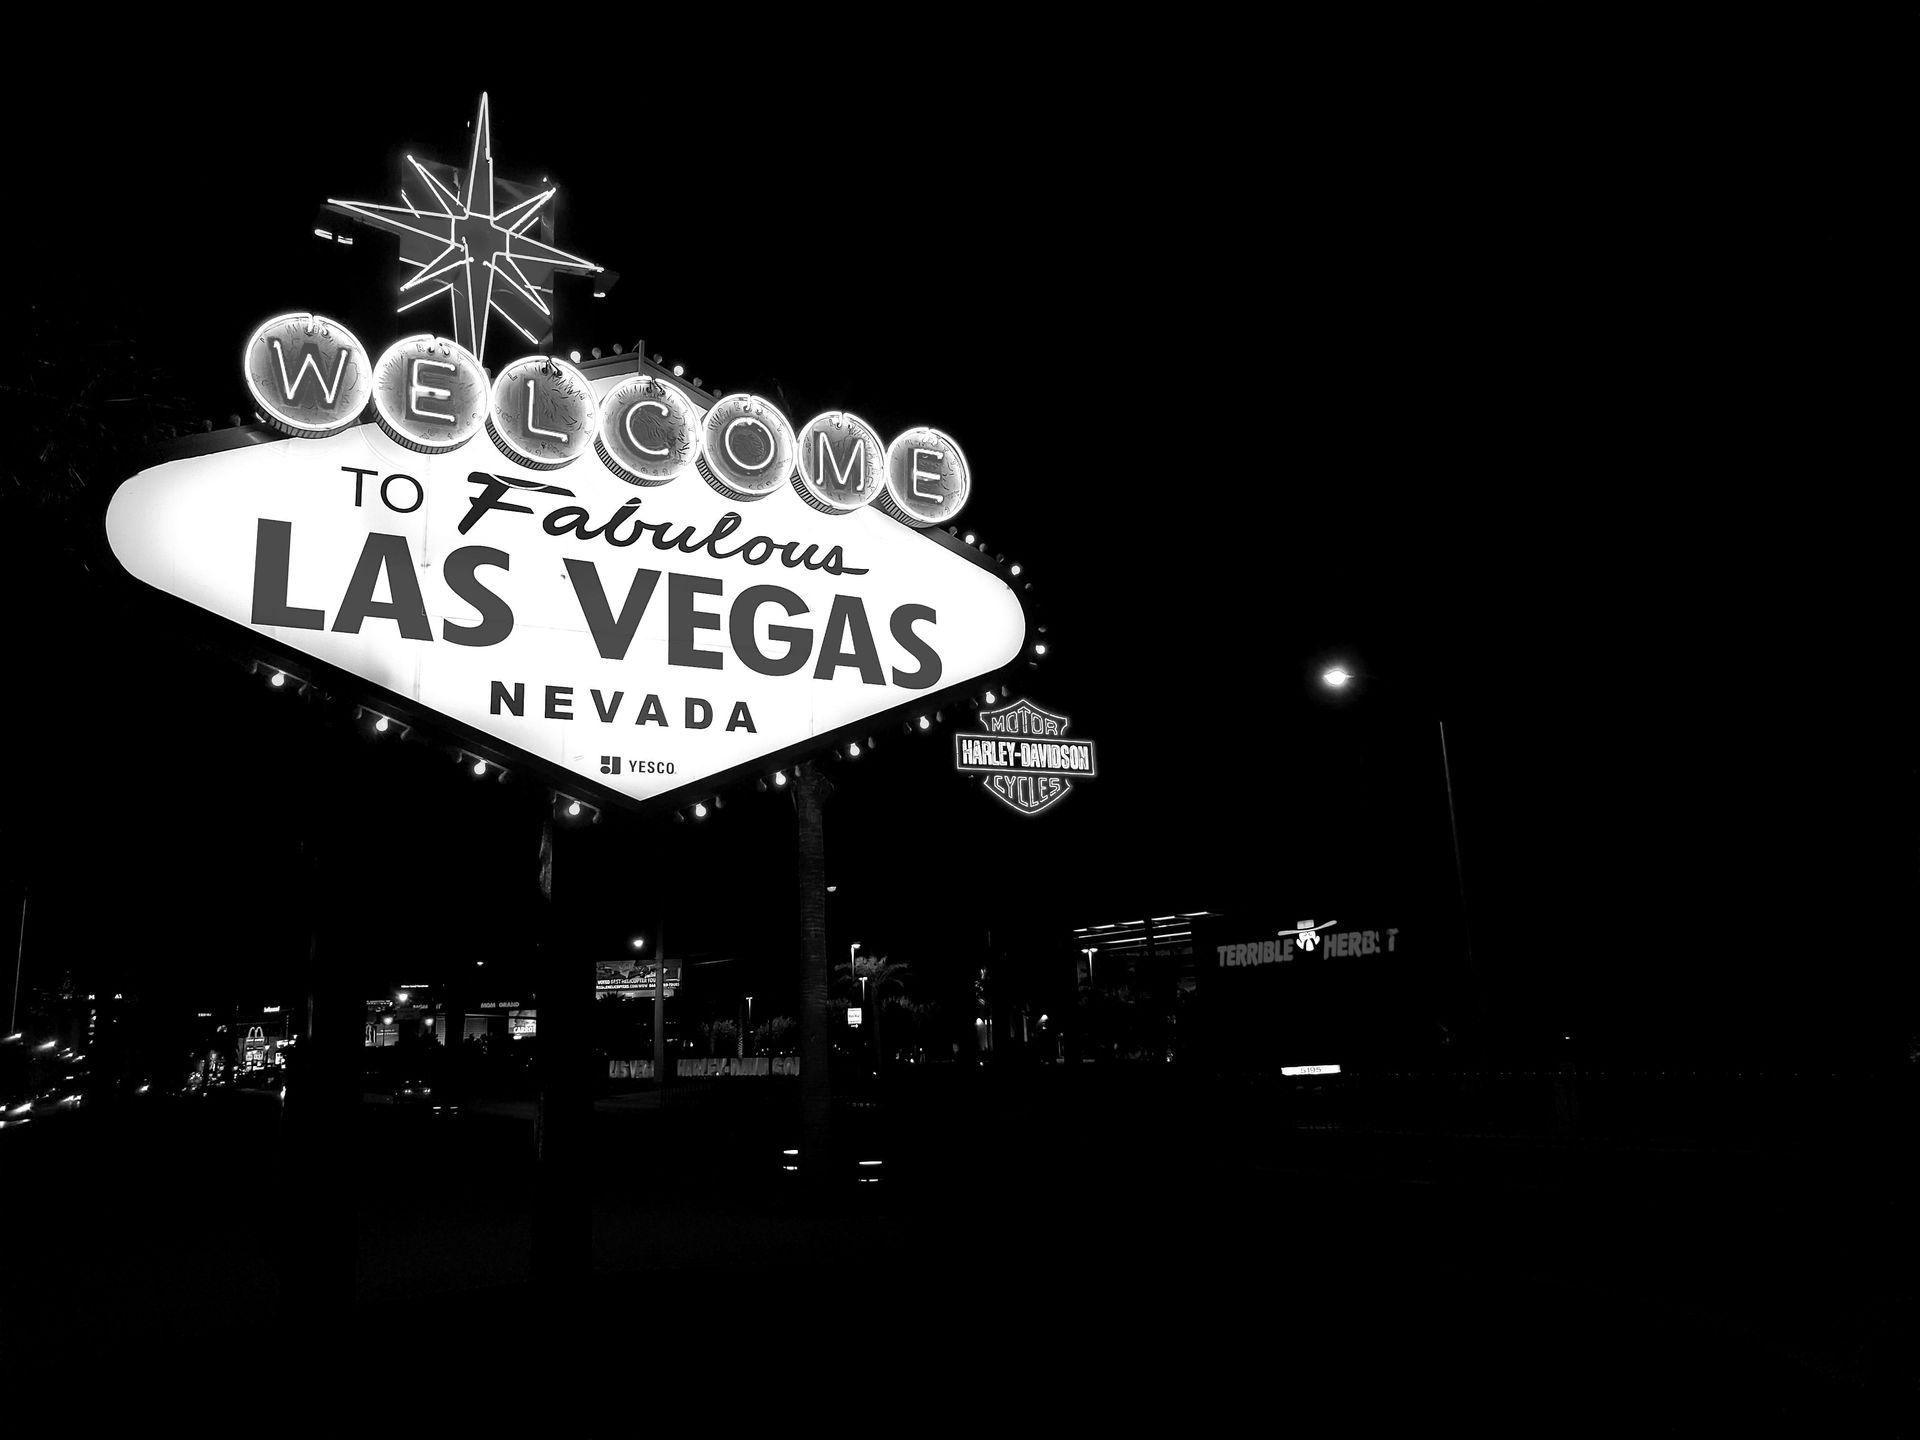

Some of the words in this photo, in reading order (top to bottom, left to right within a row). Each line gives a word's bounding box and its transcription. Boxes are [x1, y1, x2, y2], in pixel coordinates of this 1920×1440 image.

[262, 330, 948, 506] WELCOME
[341, 466, 424, 513] TO
[458, 471, 869, 575] Fabulous
[251, 518, 514, 647] LAS
[563, 557, 943, 689] VEGAS
[490, 680, 758, 733] NEVADA
[991, 706, 1058, 735] MOTOR
[629, 760, 674, 775] YESCO
[962, 739, 1090, 770] HARLEY-DAVIDSON
[994, 775, 1061, 807] CYCLES
[1217, 938, 1294, 968] TERRIBLE
[1300, 1066, 1322, 1074] 5195
